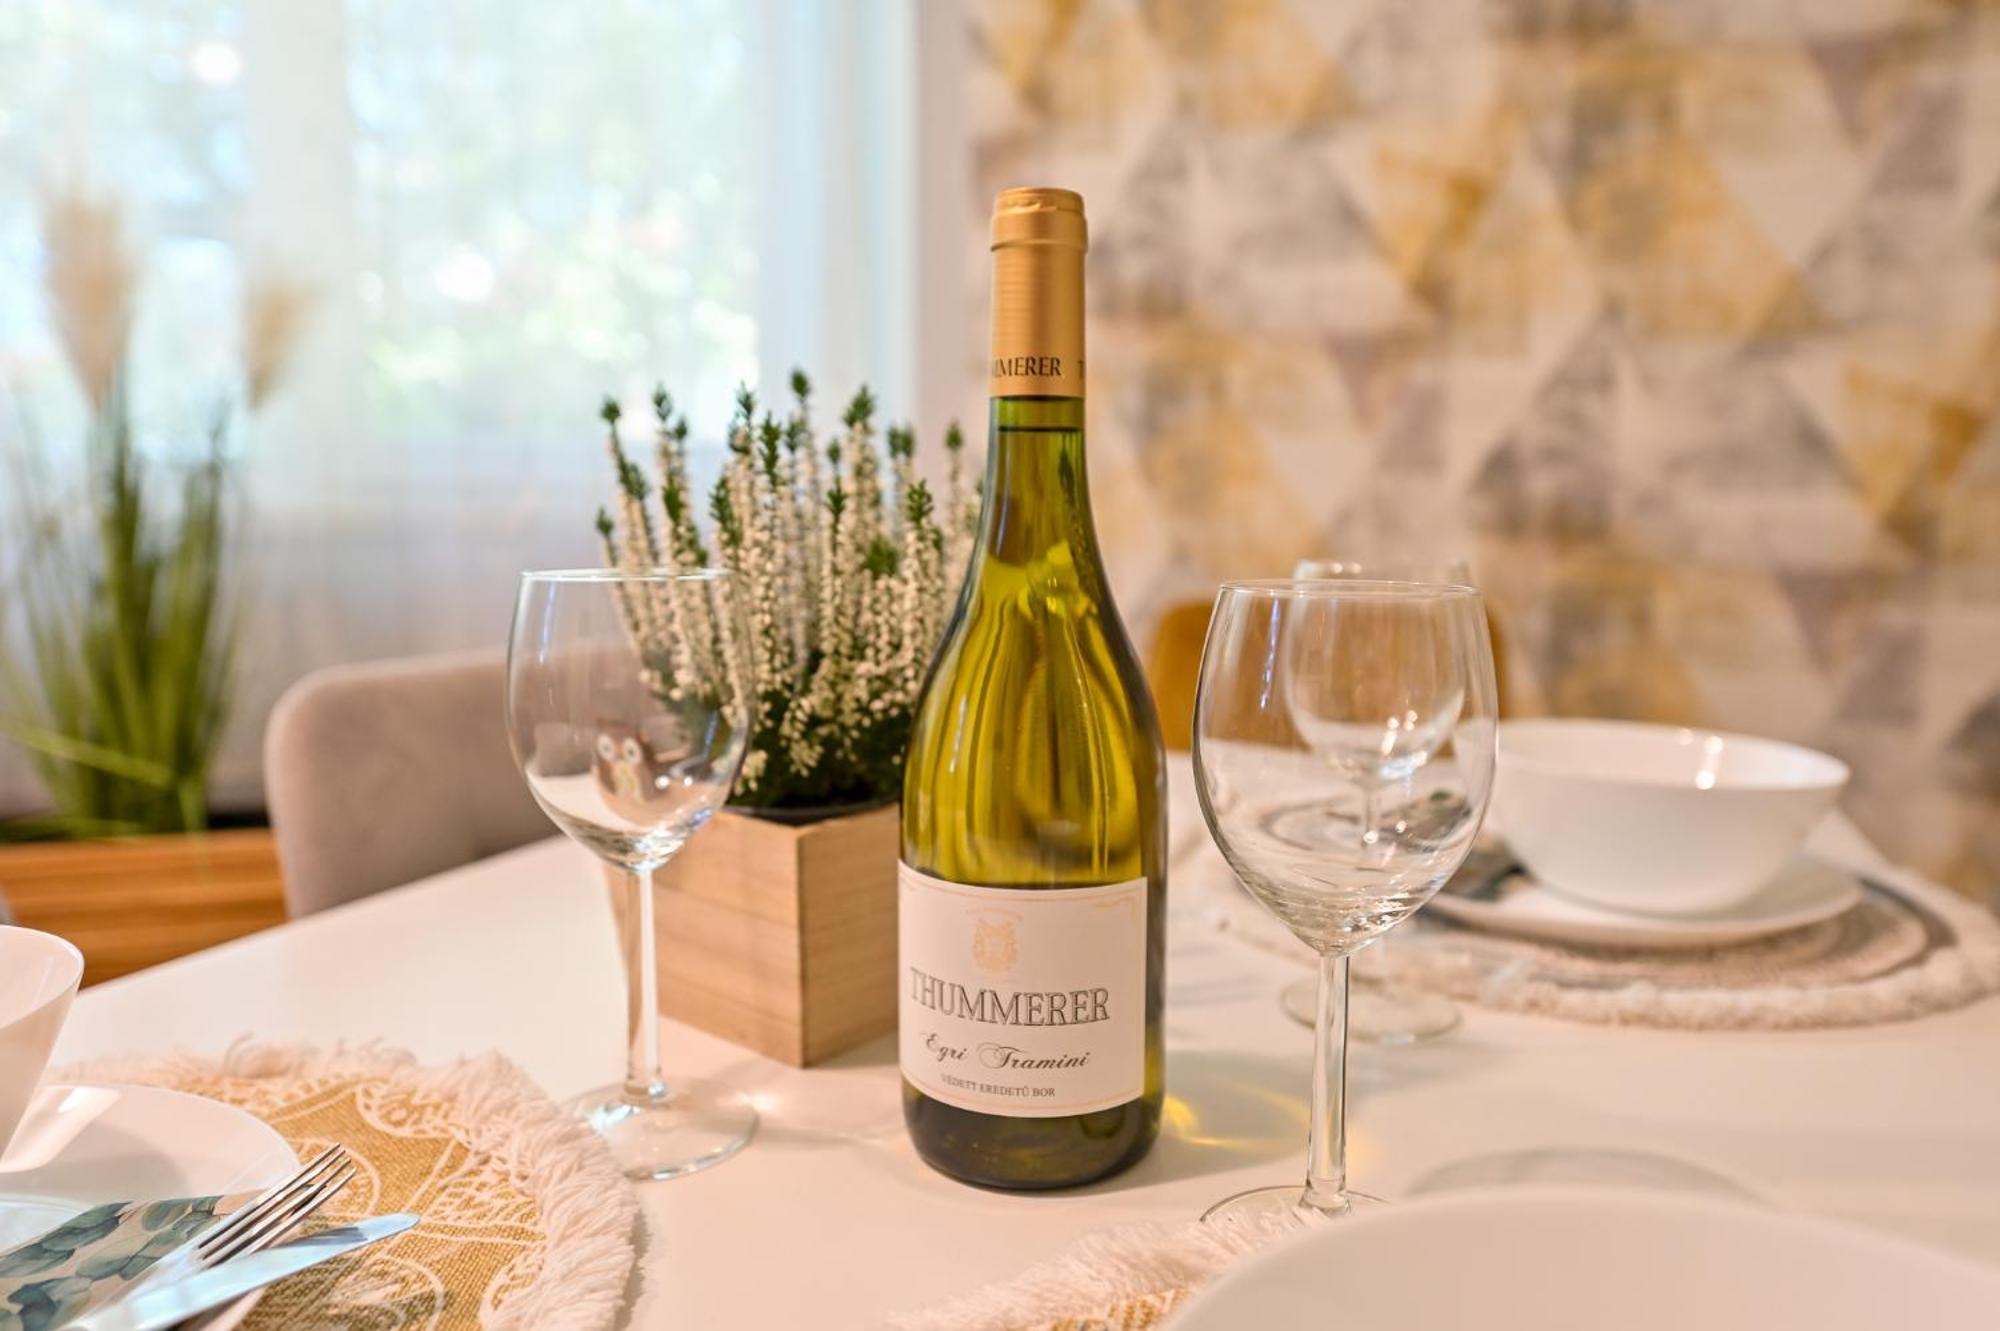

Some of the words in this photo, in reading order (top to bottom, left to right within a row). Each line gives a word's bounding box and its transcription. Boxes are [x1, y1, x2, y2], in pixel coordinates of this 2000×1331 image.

[992, 355, 1062, 378] MERER
[910, 967, 1110, 1026] THUMMERER
[920, 1033, 968, 1062] Egri
[978, 1042, 1091, 1069] Tramini
[1033, 1087, 1056, 1098] BOR
